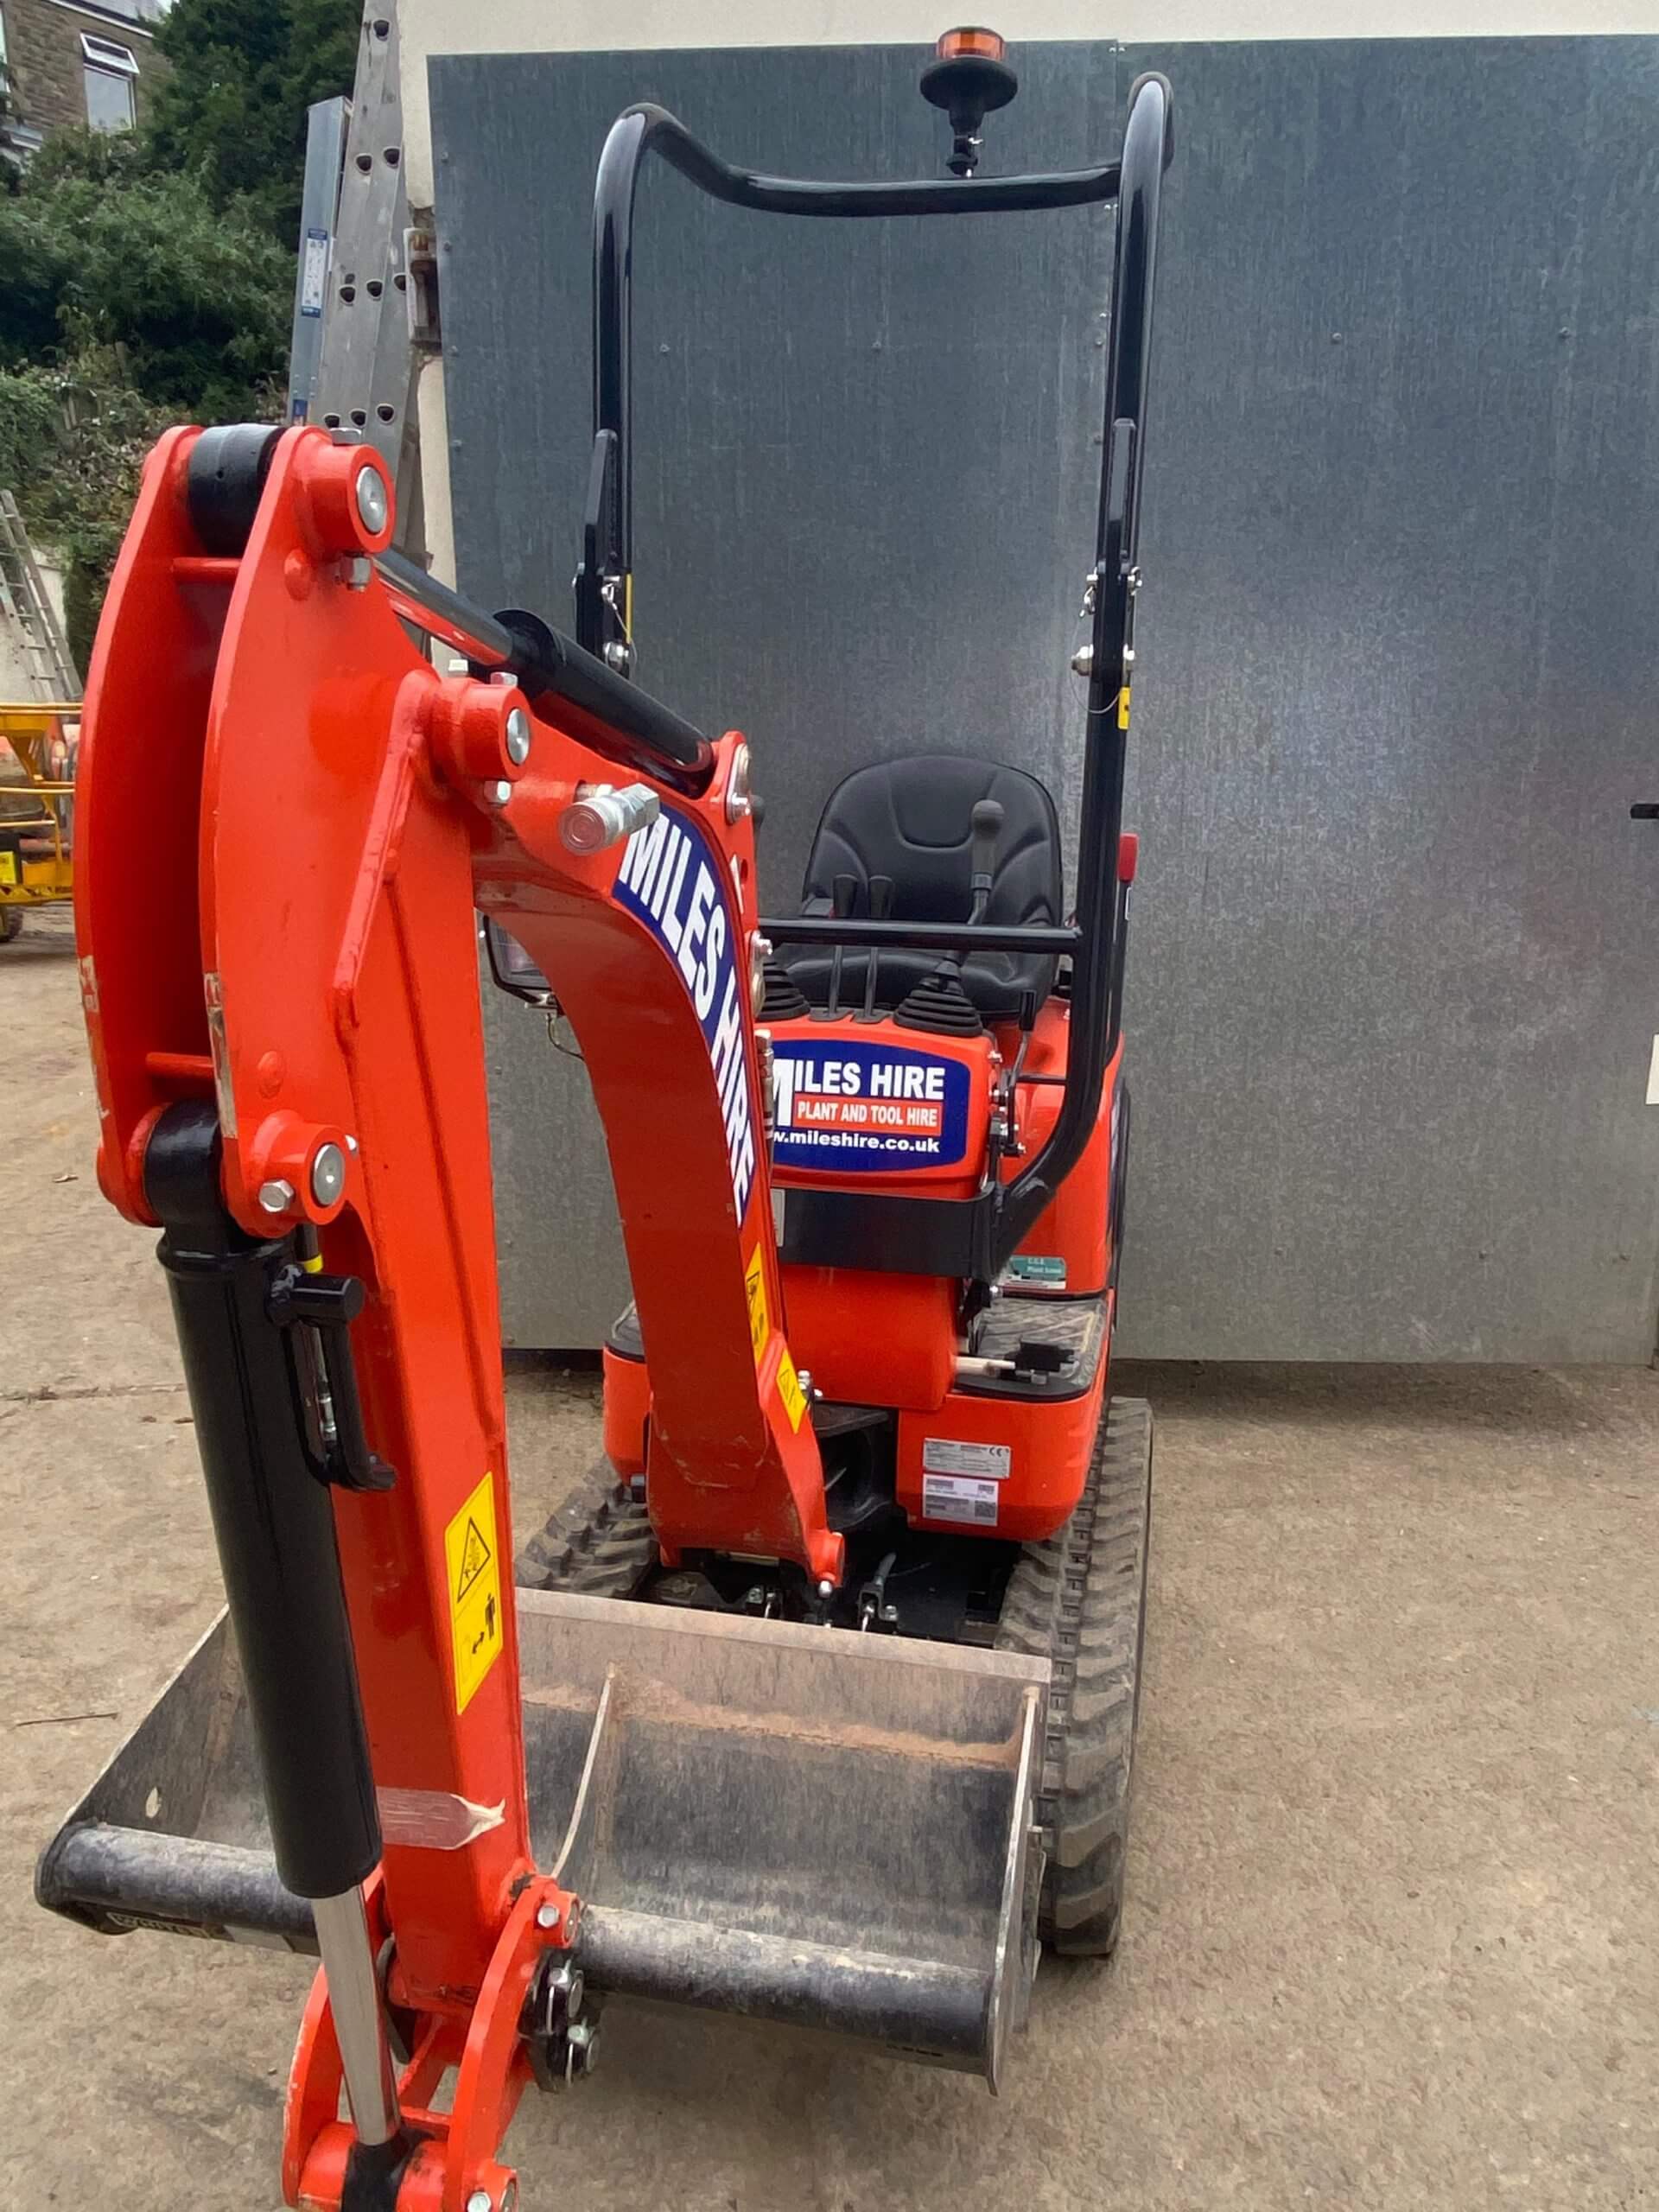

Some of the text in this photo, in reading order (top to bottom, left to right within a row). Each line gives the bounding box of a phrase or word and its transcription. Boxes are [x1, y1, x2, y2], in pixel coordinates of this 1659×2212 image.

[619, 812, 754, 1228] MILES HIRE
[870, 1064, 945, 1100] HIRE
[798, 1101, 938, 1127] PLANT AND TOOL HIRE
